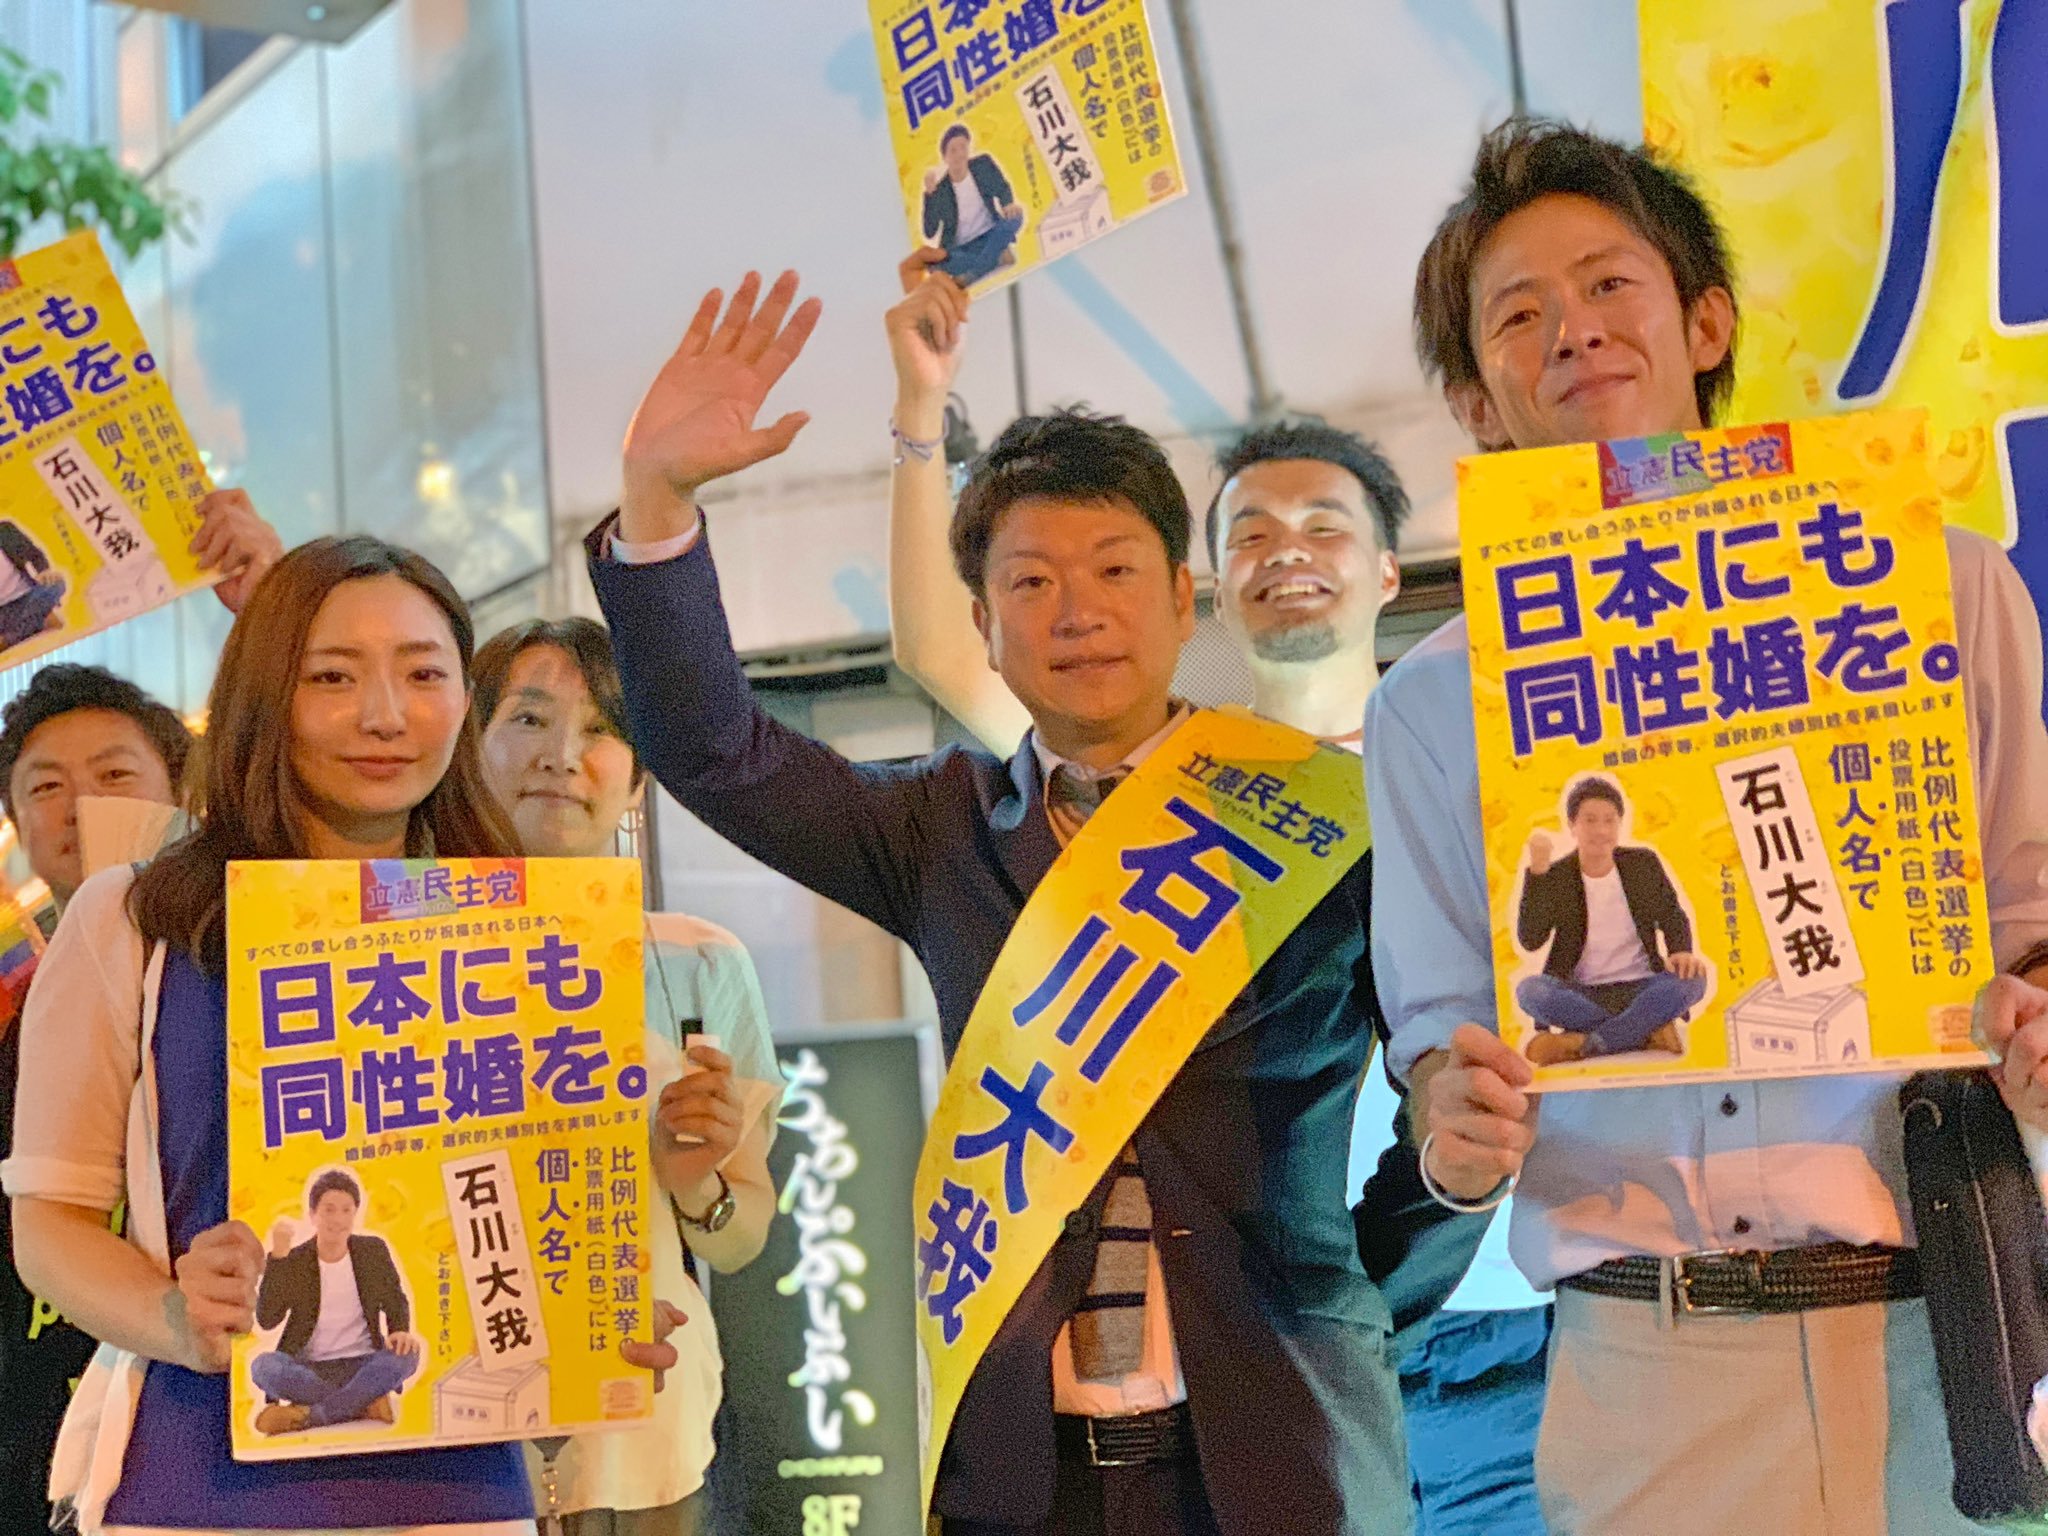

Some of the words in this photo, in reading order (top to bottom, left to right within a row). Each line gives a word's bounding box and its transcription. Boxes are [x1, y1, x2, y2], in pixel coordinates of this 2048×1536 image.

[1023, 74, 1092, 192] 石川大我
[43, 448, 140, 560] 石川大我
[1606, 436, 1783, 498] 立憲民主党
[1494, 503, 1894, 651] 日本にも
[1504, 604, 1960, 757] 同性婚を。
[1178, 751, 1347, 858] 立憲民主党
[1731, 762, 1841, 977] 石川大我
[1828, 743, 1881, 911] 個人名で
[1921, 736, 1972, 977] 比例代表選挙の
[245, 915, 563, 962] すべての愛し合うふたりが祝福される日本へ
[367, 867, 519, 909] 立憲民主党
[259, 935, 603, 1049] 日本にも
[260, 1025, 648, 1149] 同性婚を。
[917, 797, 1285, 1345] 石川大我
[455, 1163, 532, 1354] 石川大我
[536, 1149, 571, 1295] 個人名で
[610, 1145, 640, 1344] 比例代表選挙
[802, 1494, 861, 1536] 8F
